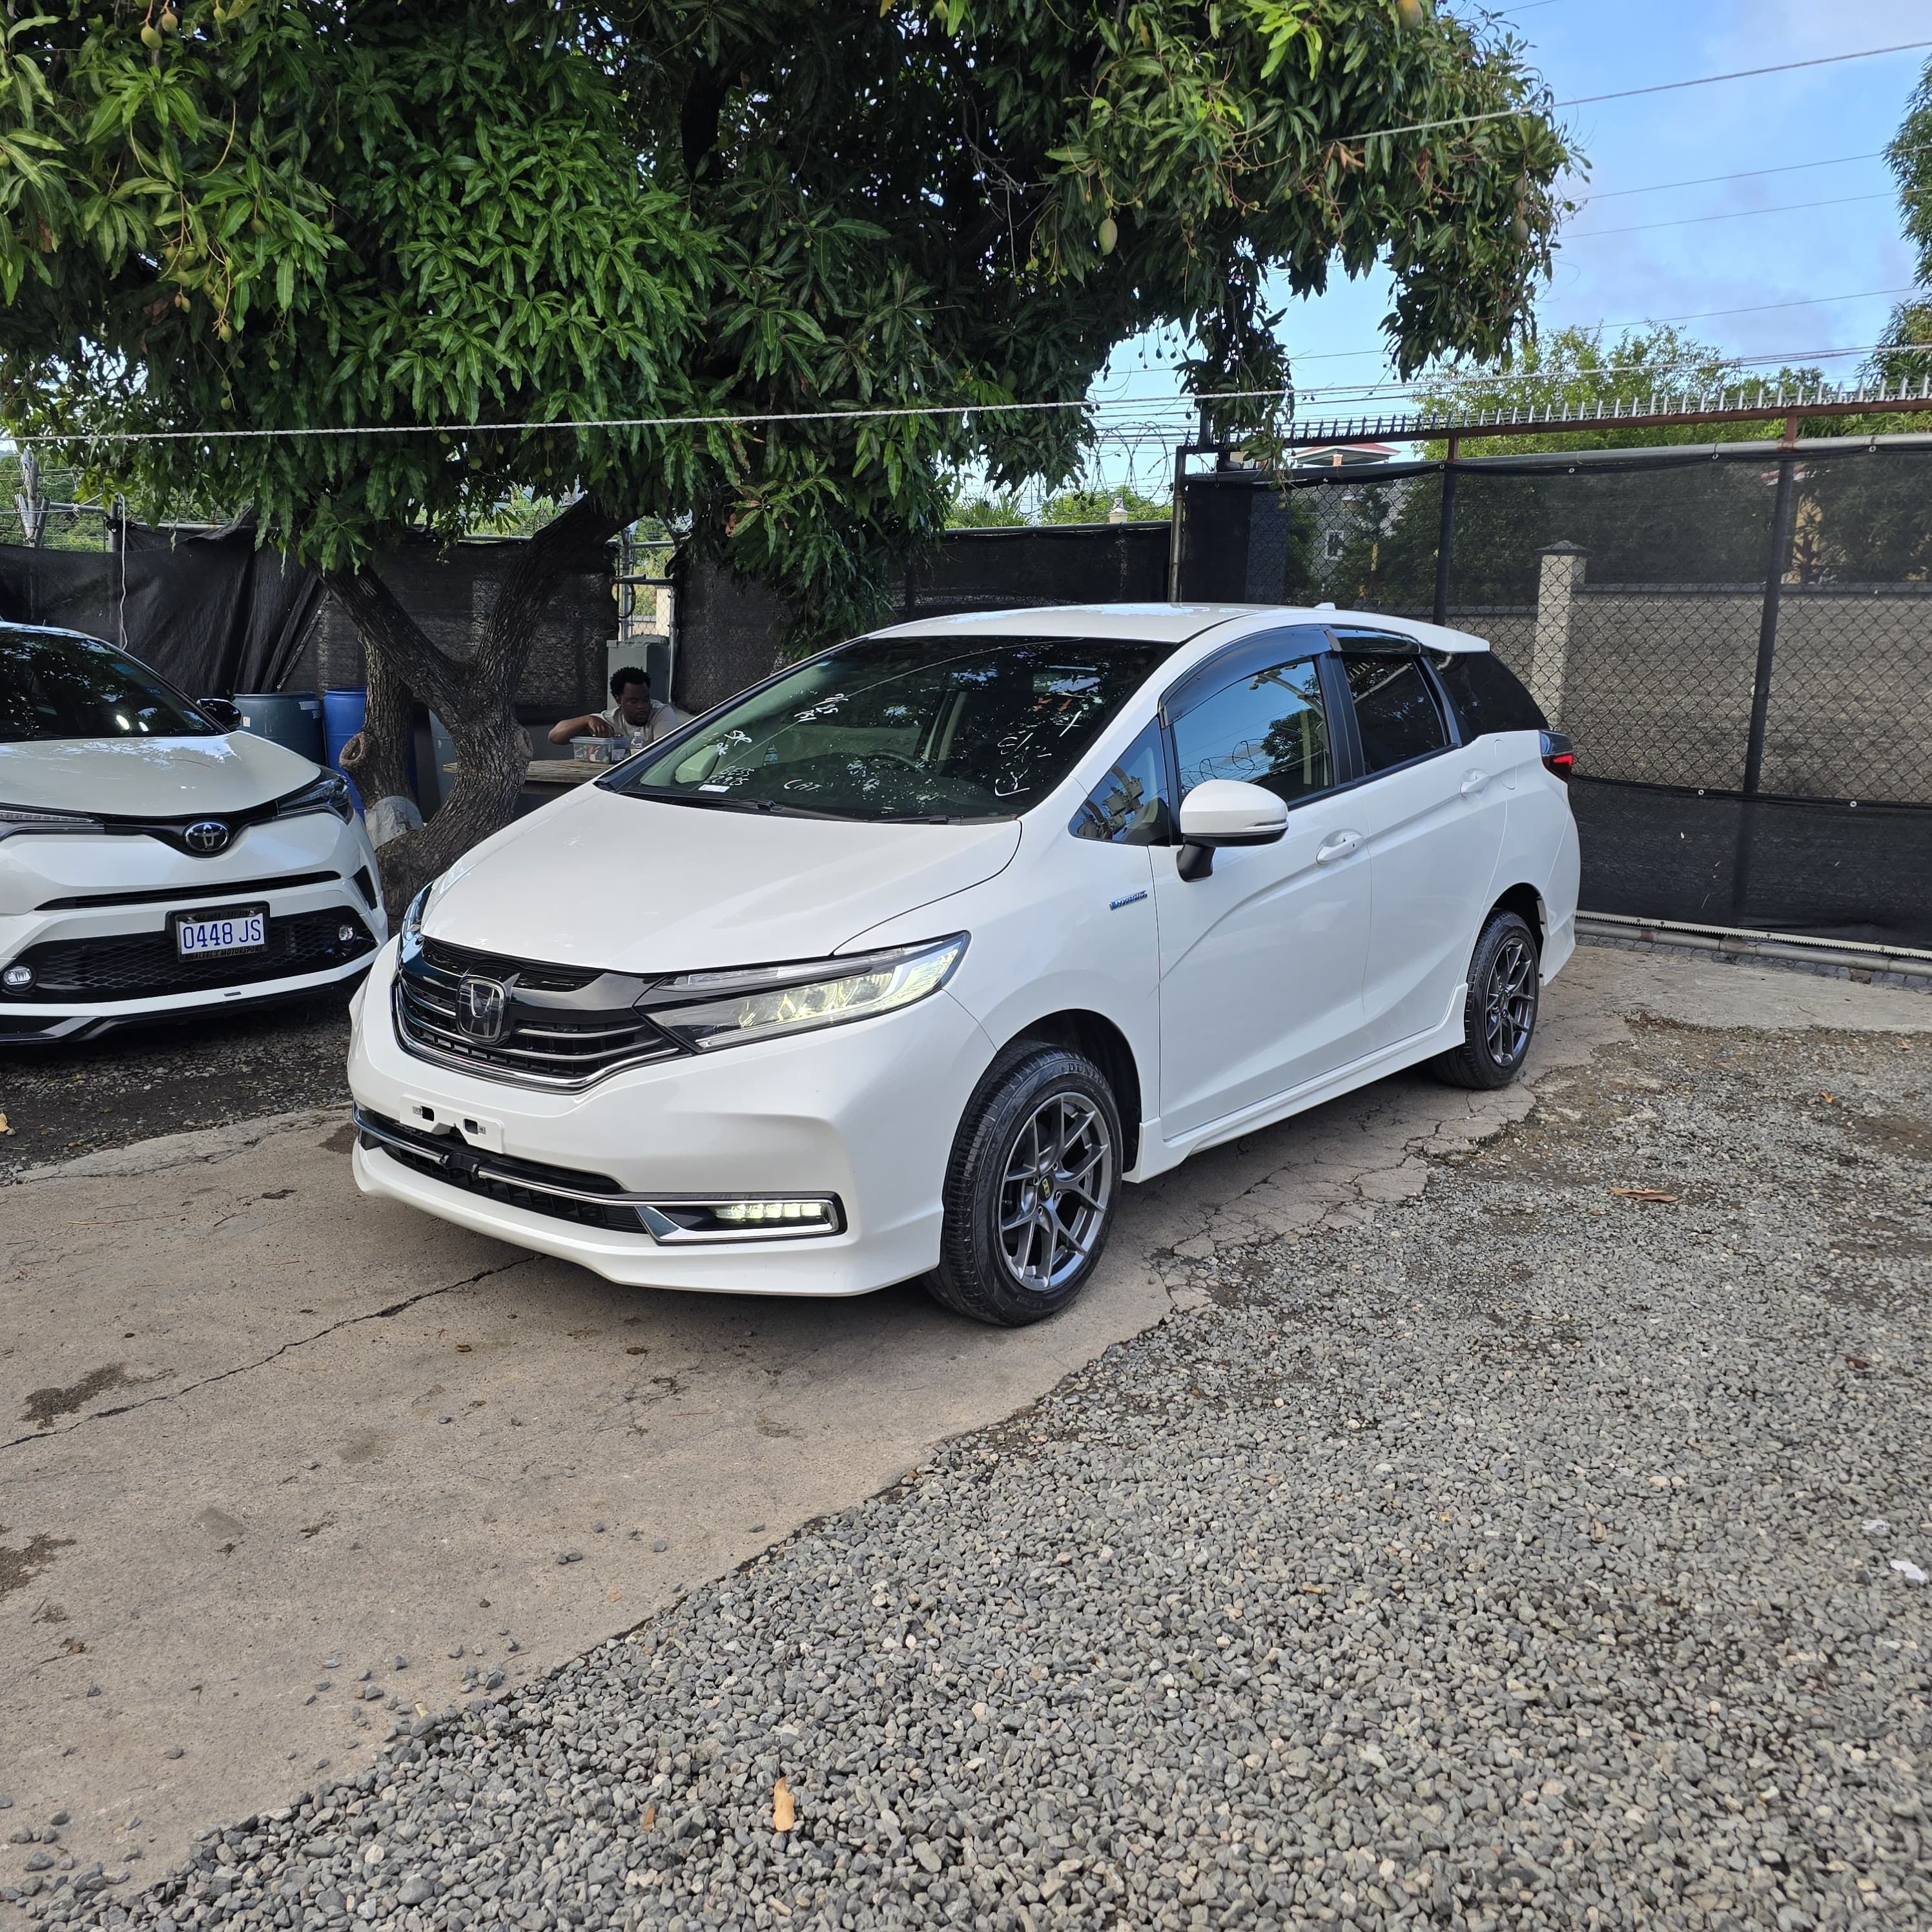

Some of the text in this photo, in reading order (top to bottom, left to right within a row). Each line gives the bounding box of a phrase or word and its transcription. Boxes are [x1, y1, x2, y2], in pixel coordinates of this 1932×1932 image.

[183, 919, 262, 949] 0448 JS
[220, 945, 263, 956] MOTORSPORT
